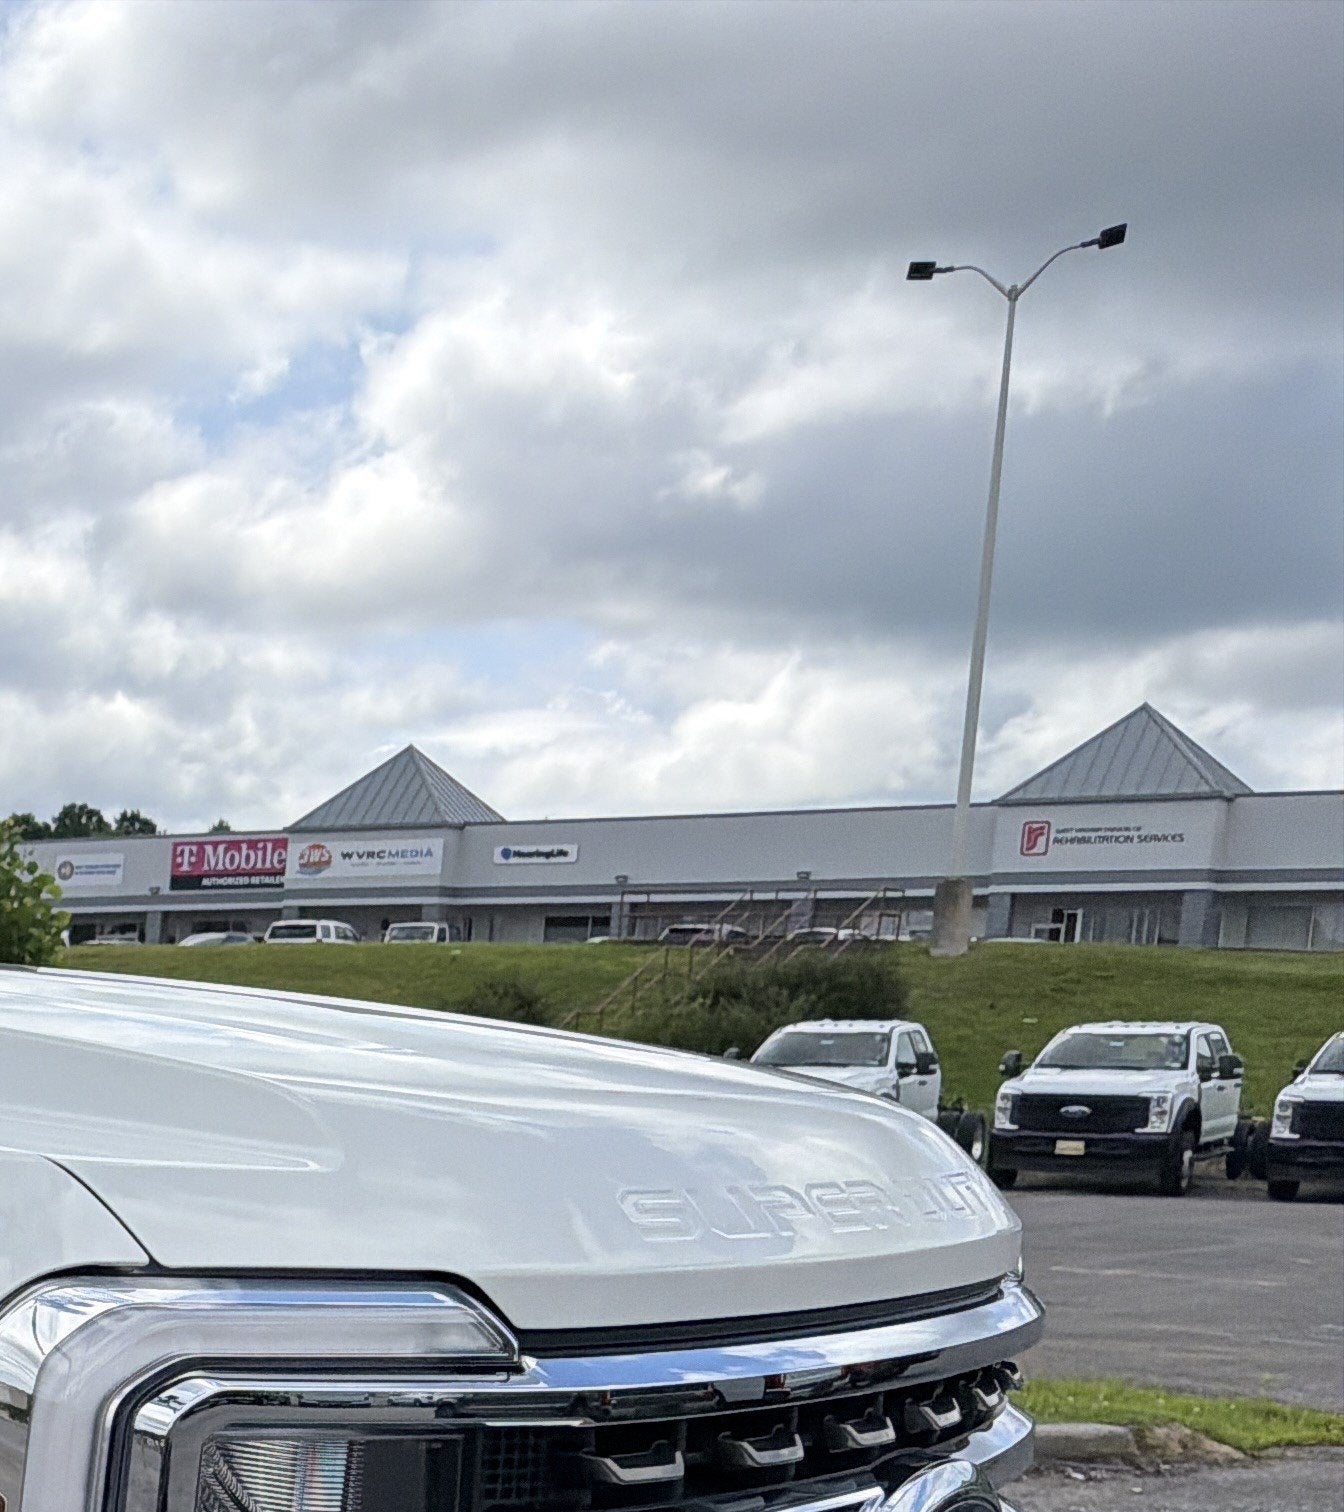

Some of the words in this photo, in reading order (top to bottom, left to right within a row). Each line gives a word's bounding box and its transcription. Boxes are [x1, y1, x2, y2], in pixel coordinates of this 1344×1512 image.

[1052, 834, 1135, 845] REHABILITATION
[1136, 832, 1185, 844] SERVICES
[202, 841, 287, 871] Mobile
